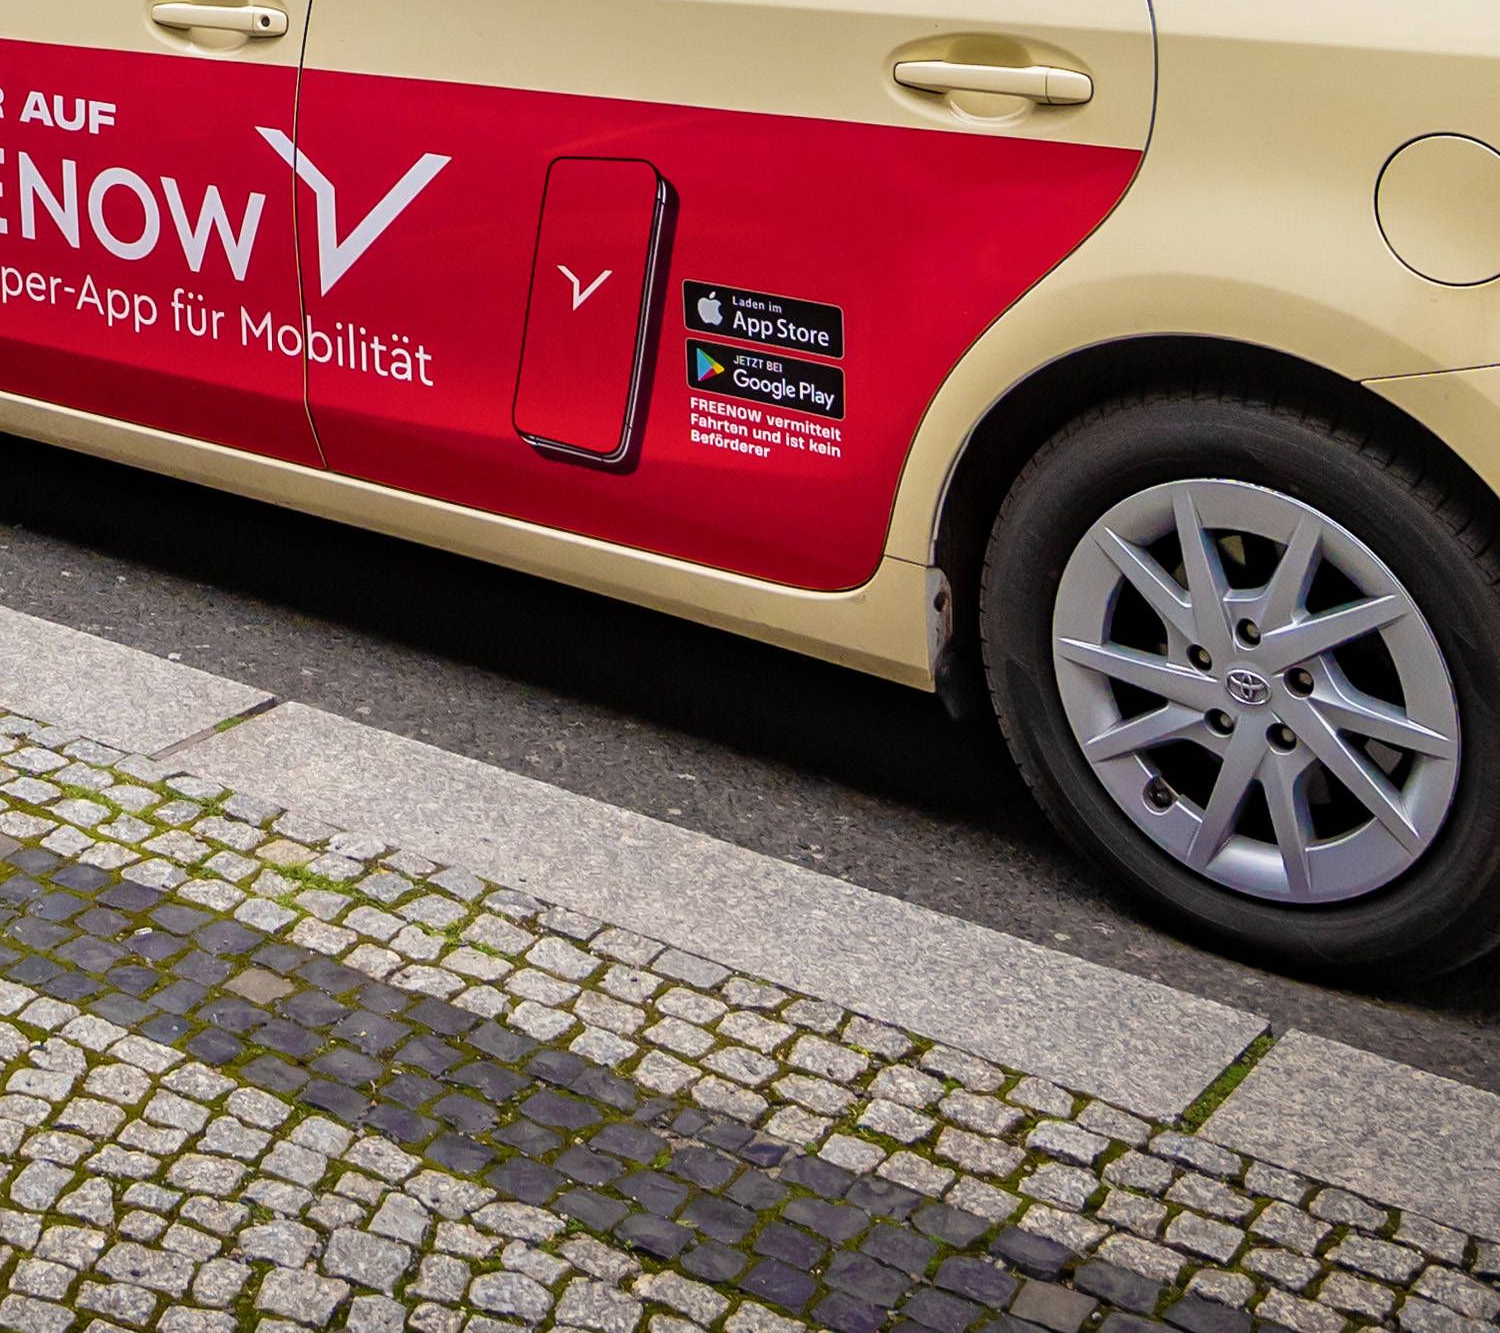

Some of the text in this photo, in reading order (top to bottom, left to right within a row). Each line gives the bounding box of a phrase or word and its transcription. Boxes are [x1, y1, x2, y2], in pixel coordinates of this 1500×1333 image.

[19, 90, 117, 134] AUF
[731, 295, 783, 314] Laden im
[170, 288, 226, 341] für
[239, 304, 435, 387] Mobilität
[732, 311, 830, 347] App Store
[732, 354, 783, 374] JETZT BEI
[732, 368, 836, 411] Google Play
[689, 396, 842, 442] FREENOW vermittelt
[689, 412, 842, 458] Fahrten und ist kein
[689, 428, 771, 459] Beförderer
